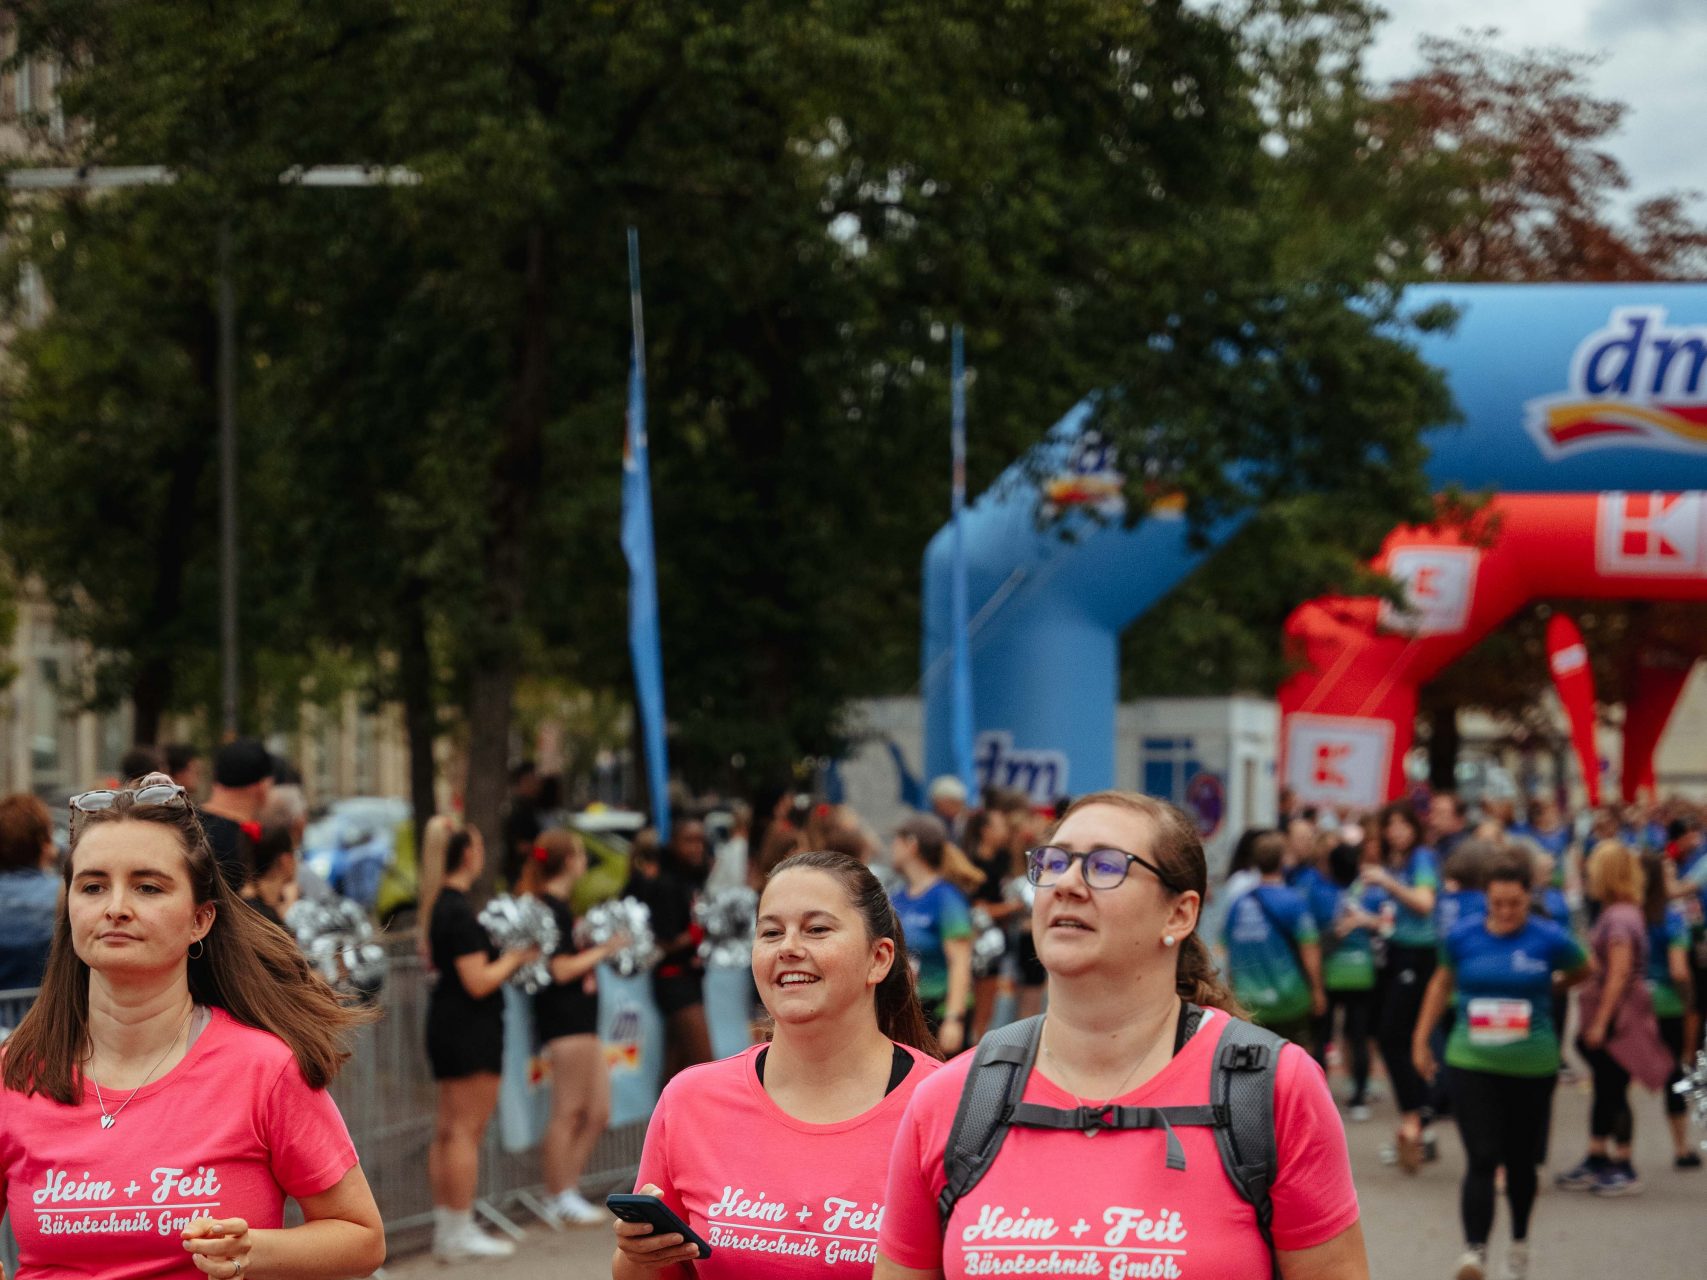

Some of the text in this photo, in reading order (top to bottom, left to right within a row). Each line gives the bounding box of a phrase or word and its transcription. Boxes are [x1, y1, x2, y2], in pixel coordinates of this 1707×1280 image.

[33, 1166, 221, 1204] Heim + Feit
[708, 1185, 788, 1222] Heim
[795, 1205, 813, 1223] +
[38, 1212, 153, 1235] Bürotechnik
[962, 1204, 1188, 1246] Heim + Feit
[708, 1227, 821, 1257] Bürotechnik
[964, 1251, 1104, 1276] Bürotechnik
